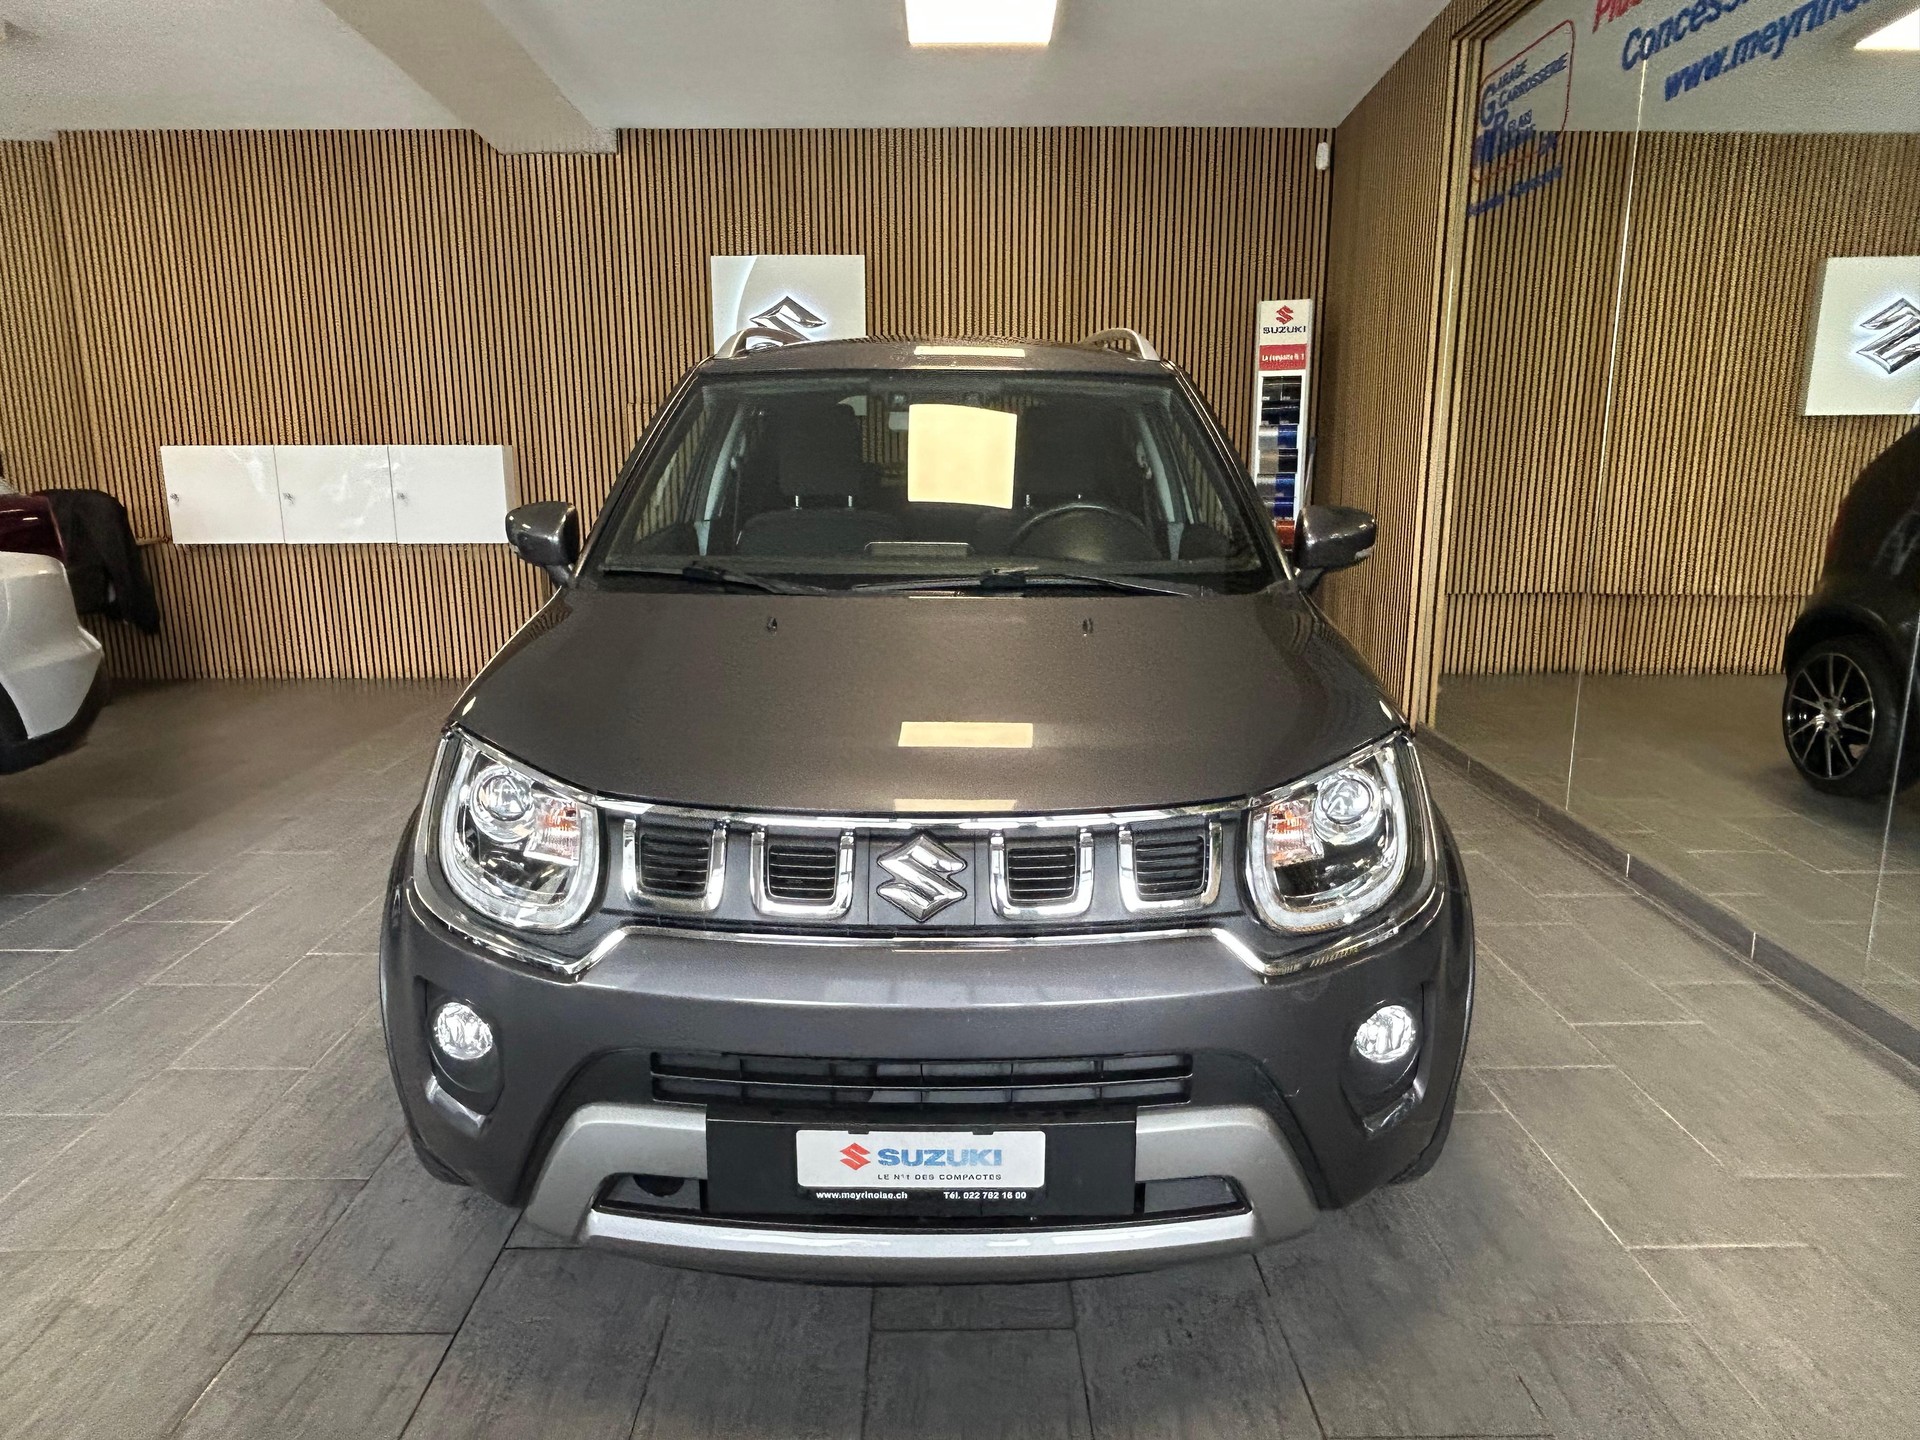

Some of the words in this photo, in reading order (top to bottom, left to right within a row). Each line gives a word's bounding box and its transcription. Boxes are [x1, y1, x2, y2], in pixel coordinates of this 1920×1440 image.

[1262, 325, 1306, 335] SUZUKI
[877, 1148, 1002, 1167] SUZUKI
[963, 1191, 981, 1200] 022
